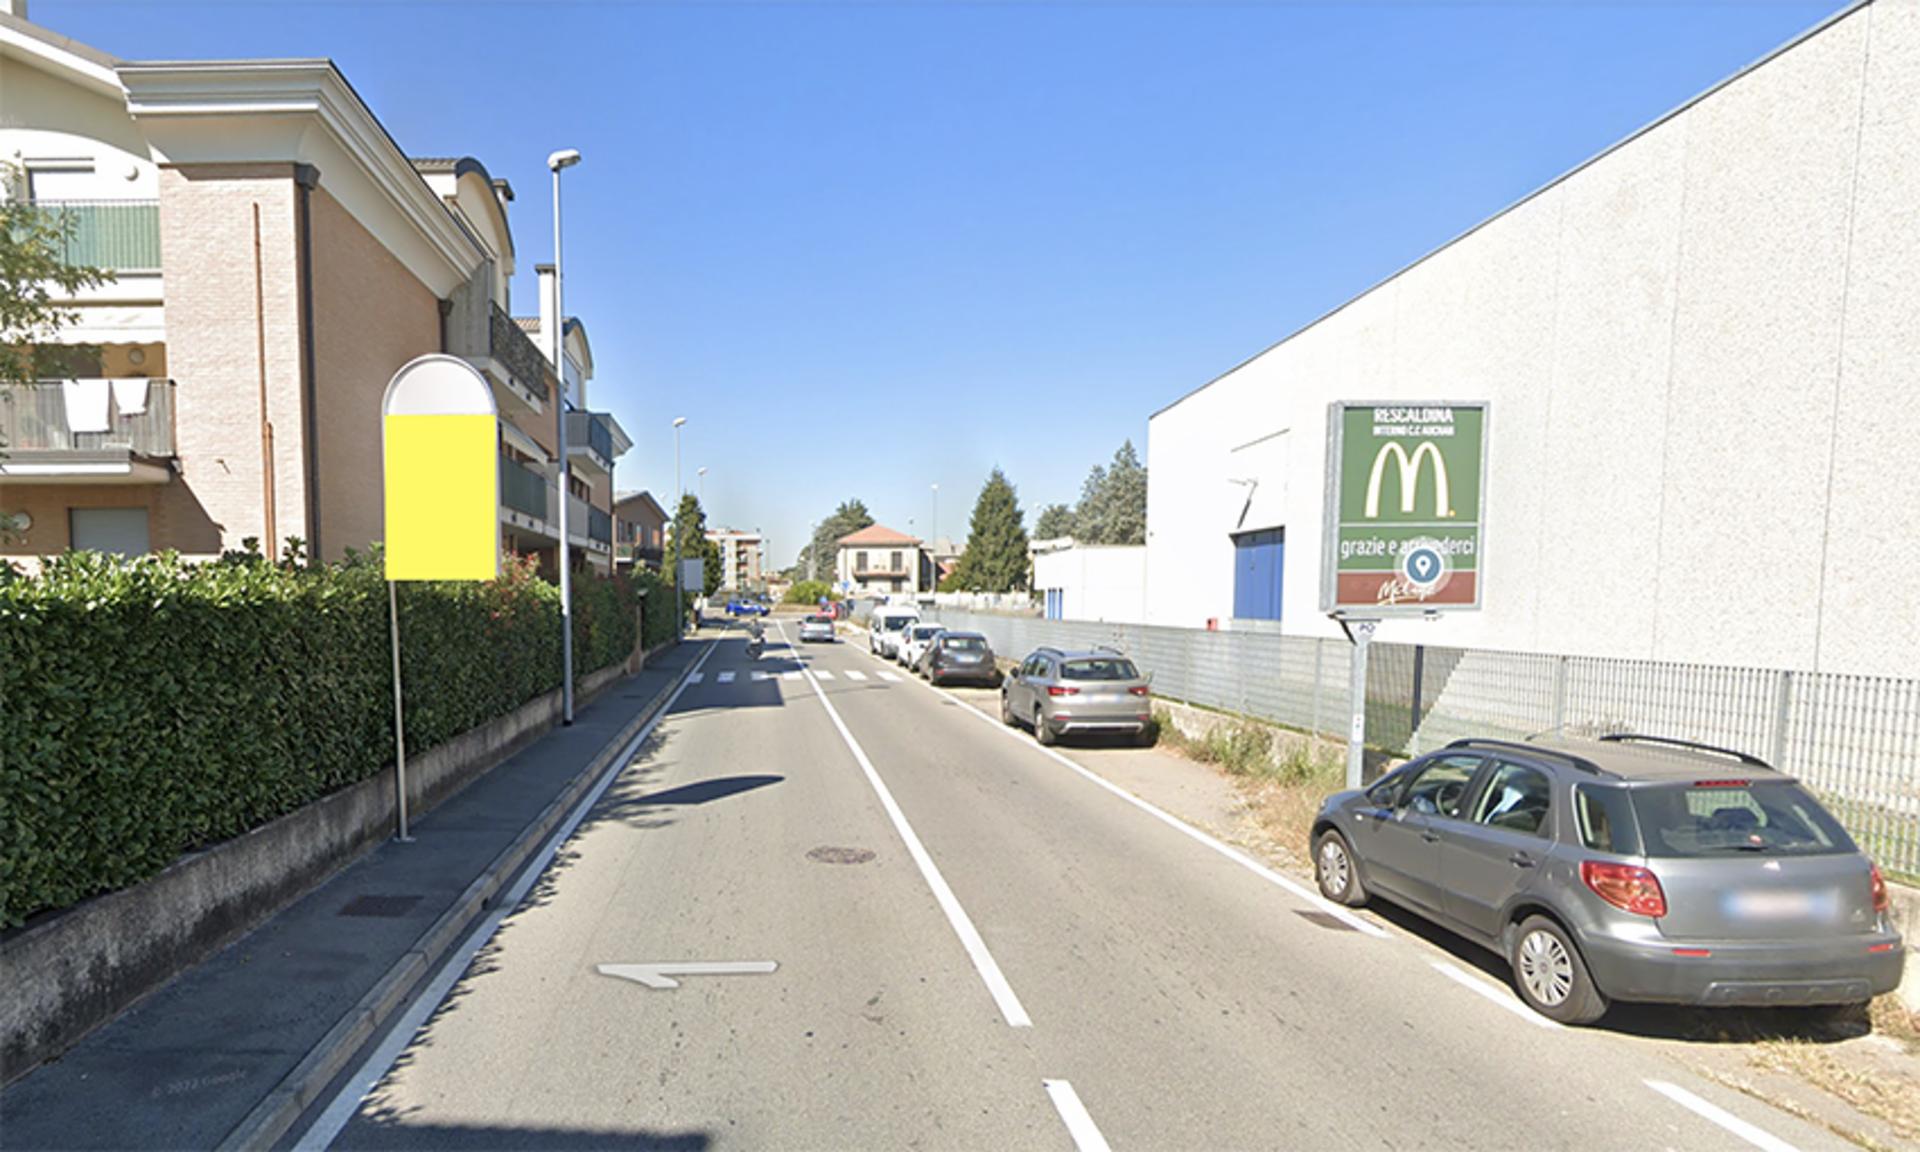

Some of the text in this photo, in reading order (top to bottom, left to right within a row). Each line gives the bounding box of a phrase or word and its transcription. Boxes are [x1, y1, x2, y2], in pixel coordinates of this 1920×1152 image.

[1374, 408, 1454, 423] RESCALDINA
[1341, 536, 1386, 559] grazie
[1388, 540, 1397, 555] e
